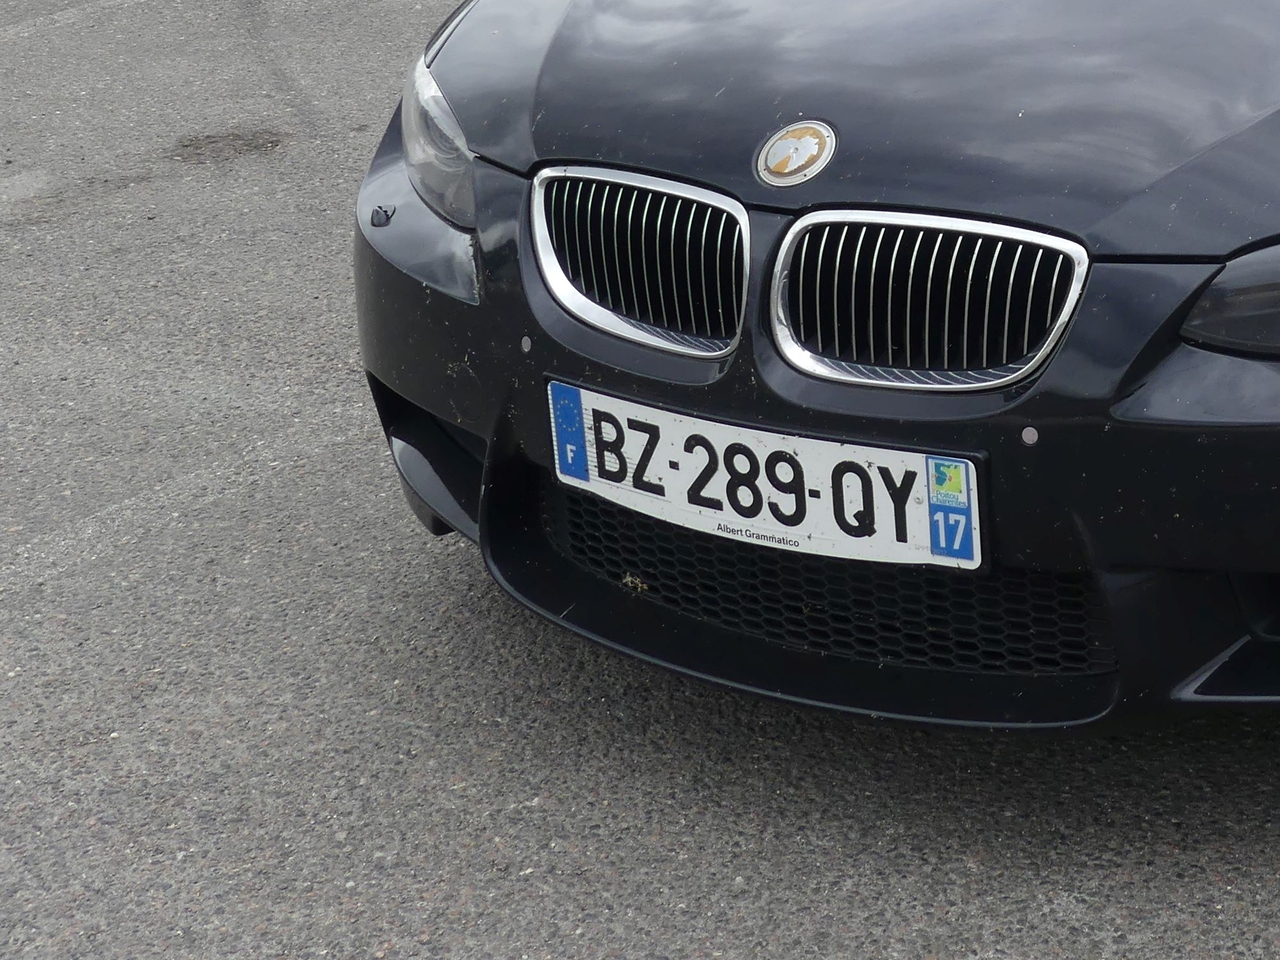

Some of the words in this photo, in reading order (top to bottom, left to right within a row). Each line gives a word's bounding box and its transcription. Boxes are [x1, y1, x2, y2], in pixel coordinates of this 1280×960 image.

[567, 444, 575, 464] F
[591, 407, 918, 543] BZ-289-QY
[931, 496, 968, 508] Charentes
[716, 523, 744, 537] Albert
[744, 528, 800, 548] Grammatico
[933, 511, 966, 550] 17
